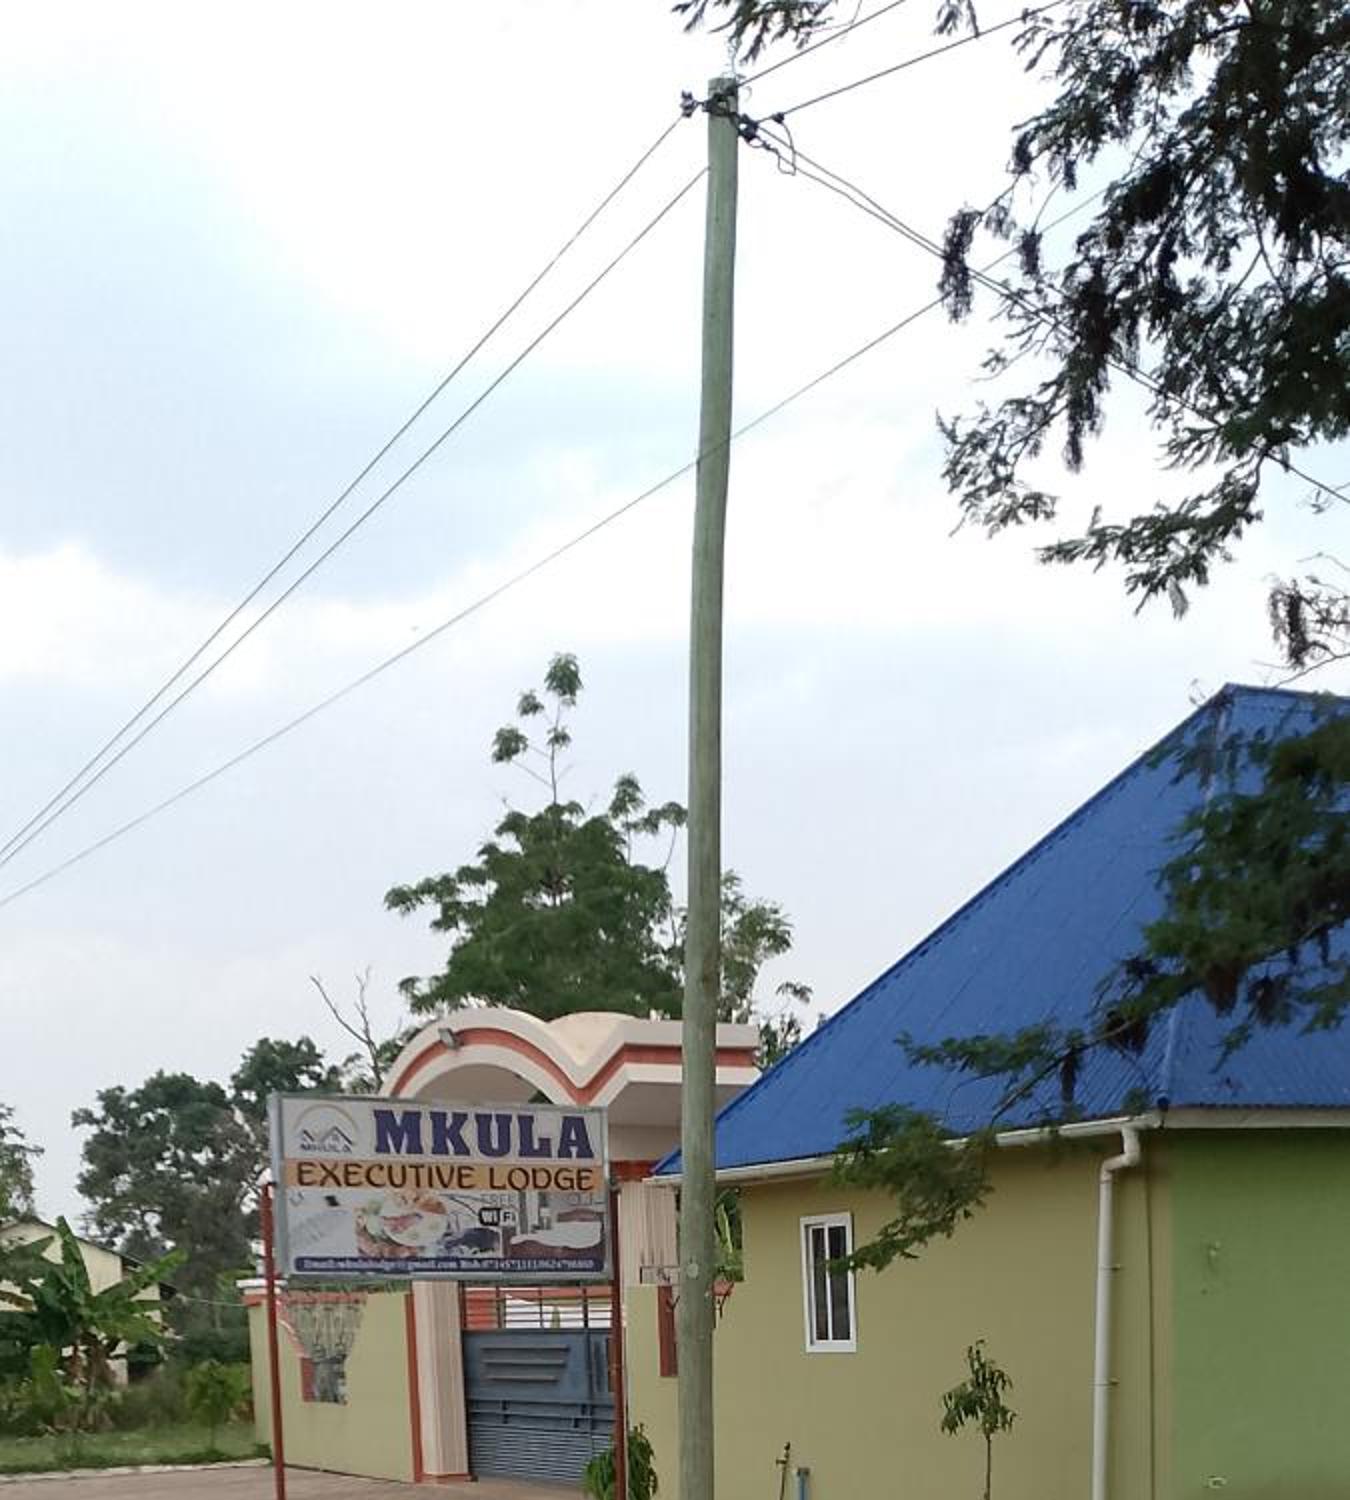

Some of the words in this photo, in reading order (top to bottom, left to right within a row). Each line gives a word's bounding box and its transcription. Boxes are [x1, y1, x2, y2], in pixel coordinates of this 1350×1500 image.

[373, 1109, 595, 1159] MKULA
[296, 1161, 476, 1190] EXECUTIVE
[489, 1166, 595, 1192] LODGE
